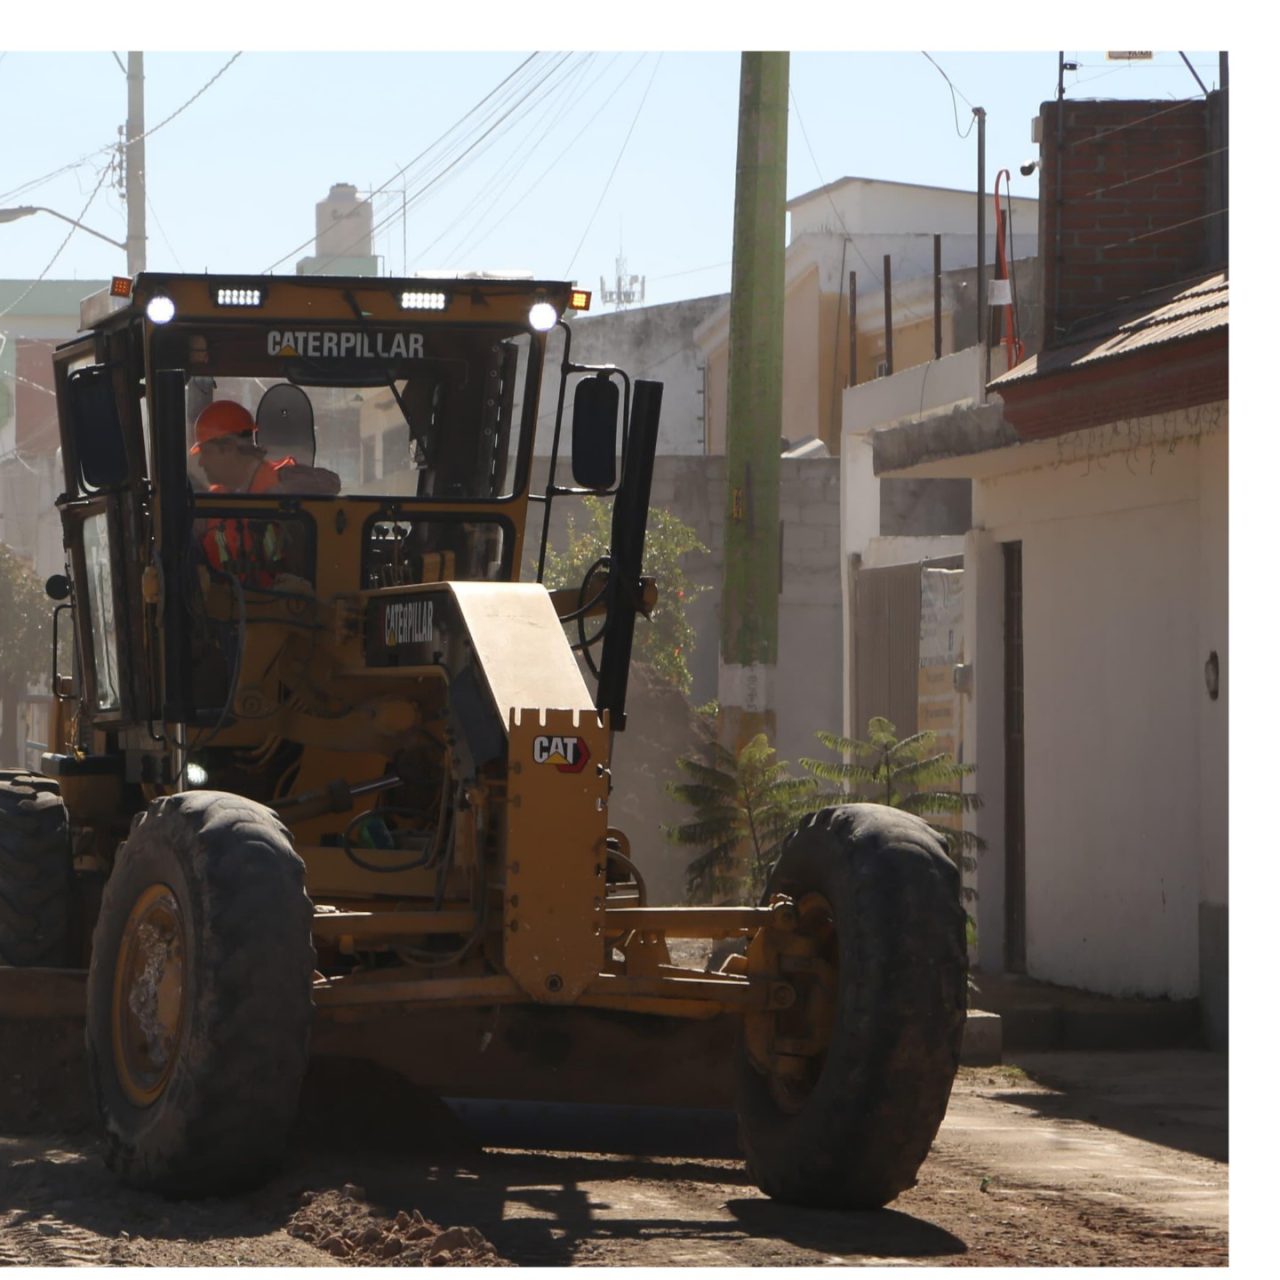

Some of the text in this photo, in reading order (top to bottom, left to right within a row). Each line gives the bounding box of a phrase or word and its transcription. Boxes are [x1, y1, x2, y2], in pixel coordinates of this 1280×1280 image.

[267, 331, 424, 358] CATERPILLAR
[385, 601, 433, 646] CATERPILLAR
[534, 736, 578, 764] CAT
